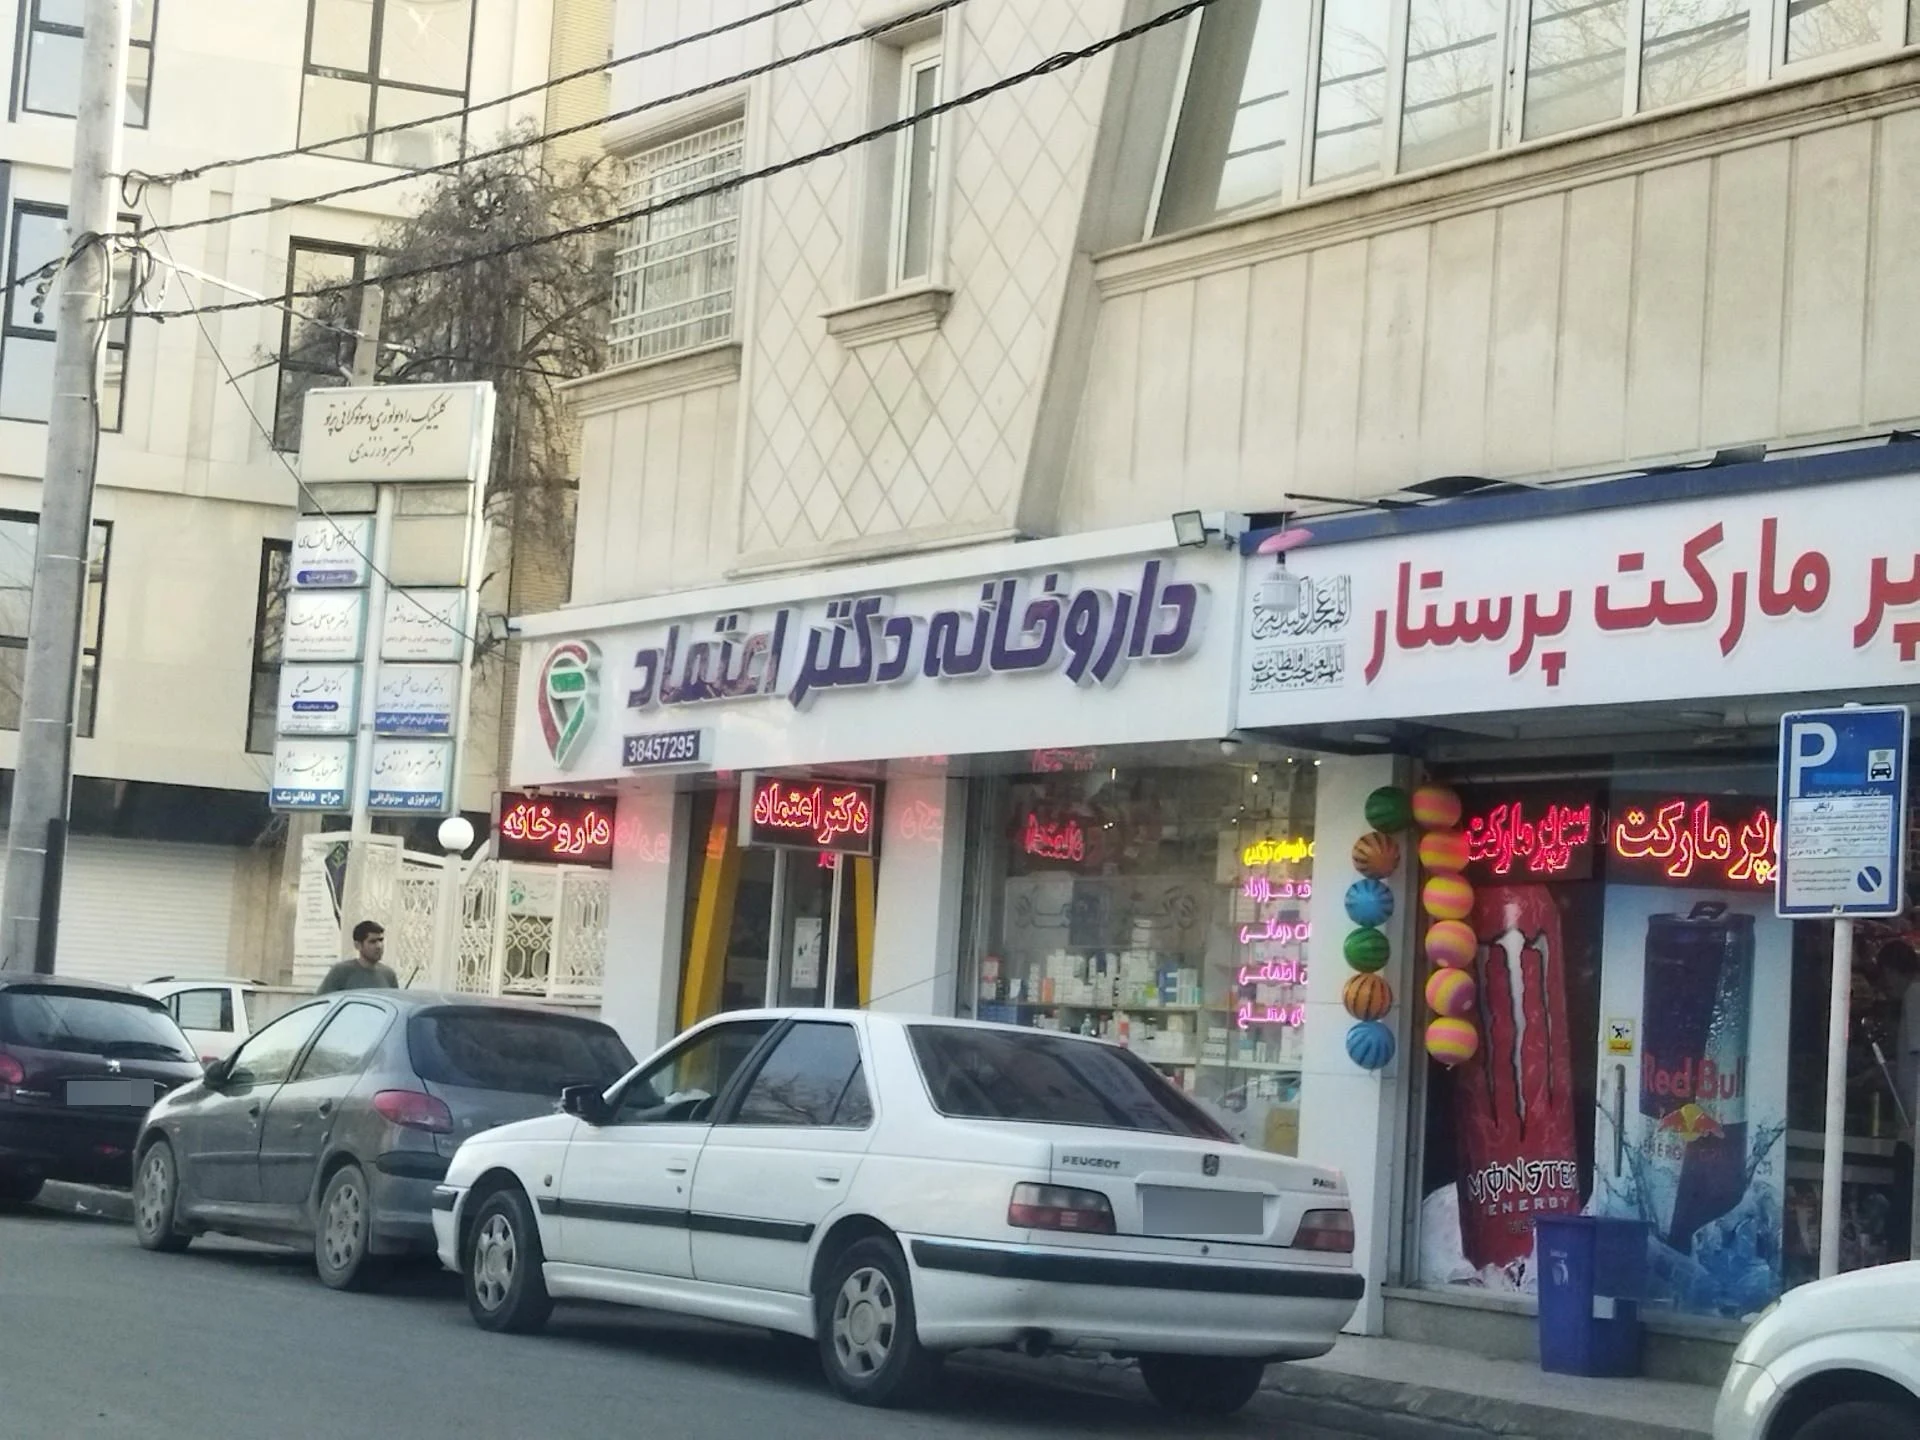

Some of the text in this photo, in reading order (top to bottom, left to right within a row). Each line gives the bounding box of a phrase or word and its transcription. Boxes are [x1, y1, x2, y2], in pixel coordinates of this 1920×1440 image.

[371, 398, 412, 432] رادیولوژی
[412, 392, 453, 430] کلینیک
[392, 423, 425, 462] دکتر
[1594, 517, 1831, 658] مارکت
[627, 560, 1200, 708] داروخانه دکتر اعتماد
[1364, 561, 1572, 687] پرستار
[628, 734, 695, 762] 38457295
[1789, 723, 1838, 797] P
[754, 783, 869, 844] دکتر اعتماد
[1617, 801, 1731, 878] مارکت
[1244, 876, 1294, 903] قرارداد
[1241, 918, 1292, 944] درمانی
[1240, 960, 1296, 986] اجتماعی
[1239, 1001, 1287, 1029] مسلح
[1061, 1156, 1121, 1169] PEUGEOT
[1488, 1196, 1570, 1216] ENERGY
